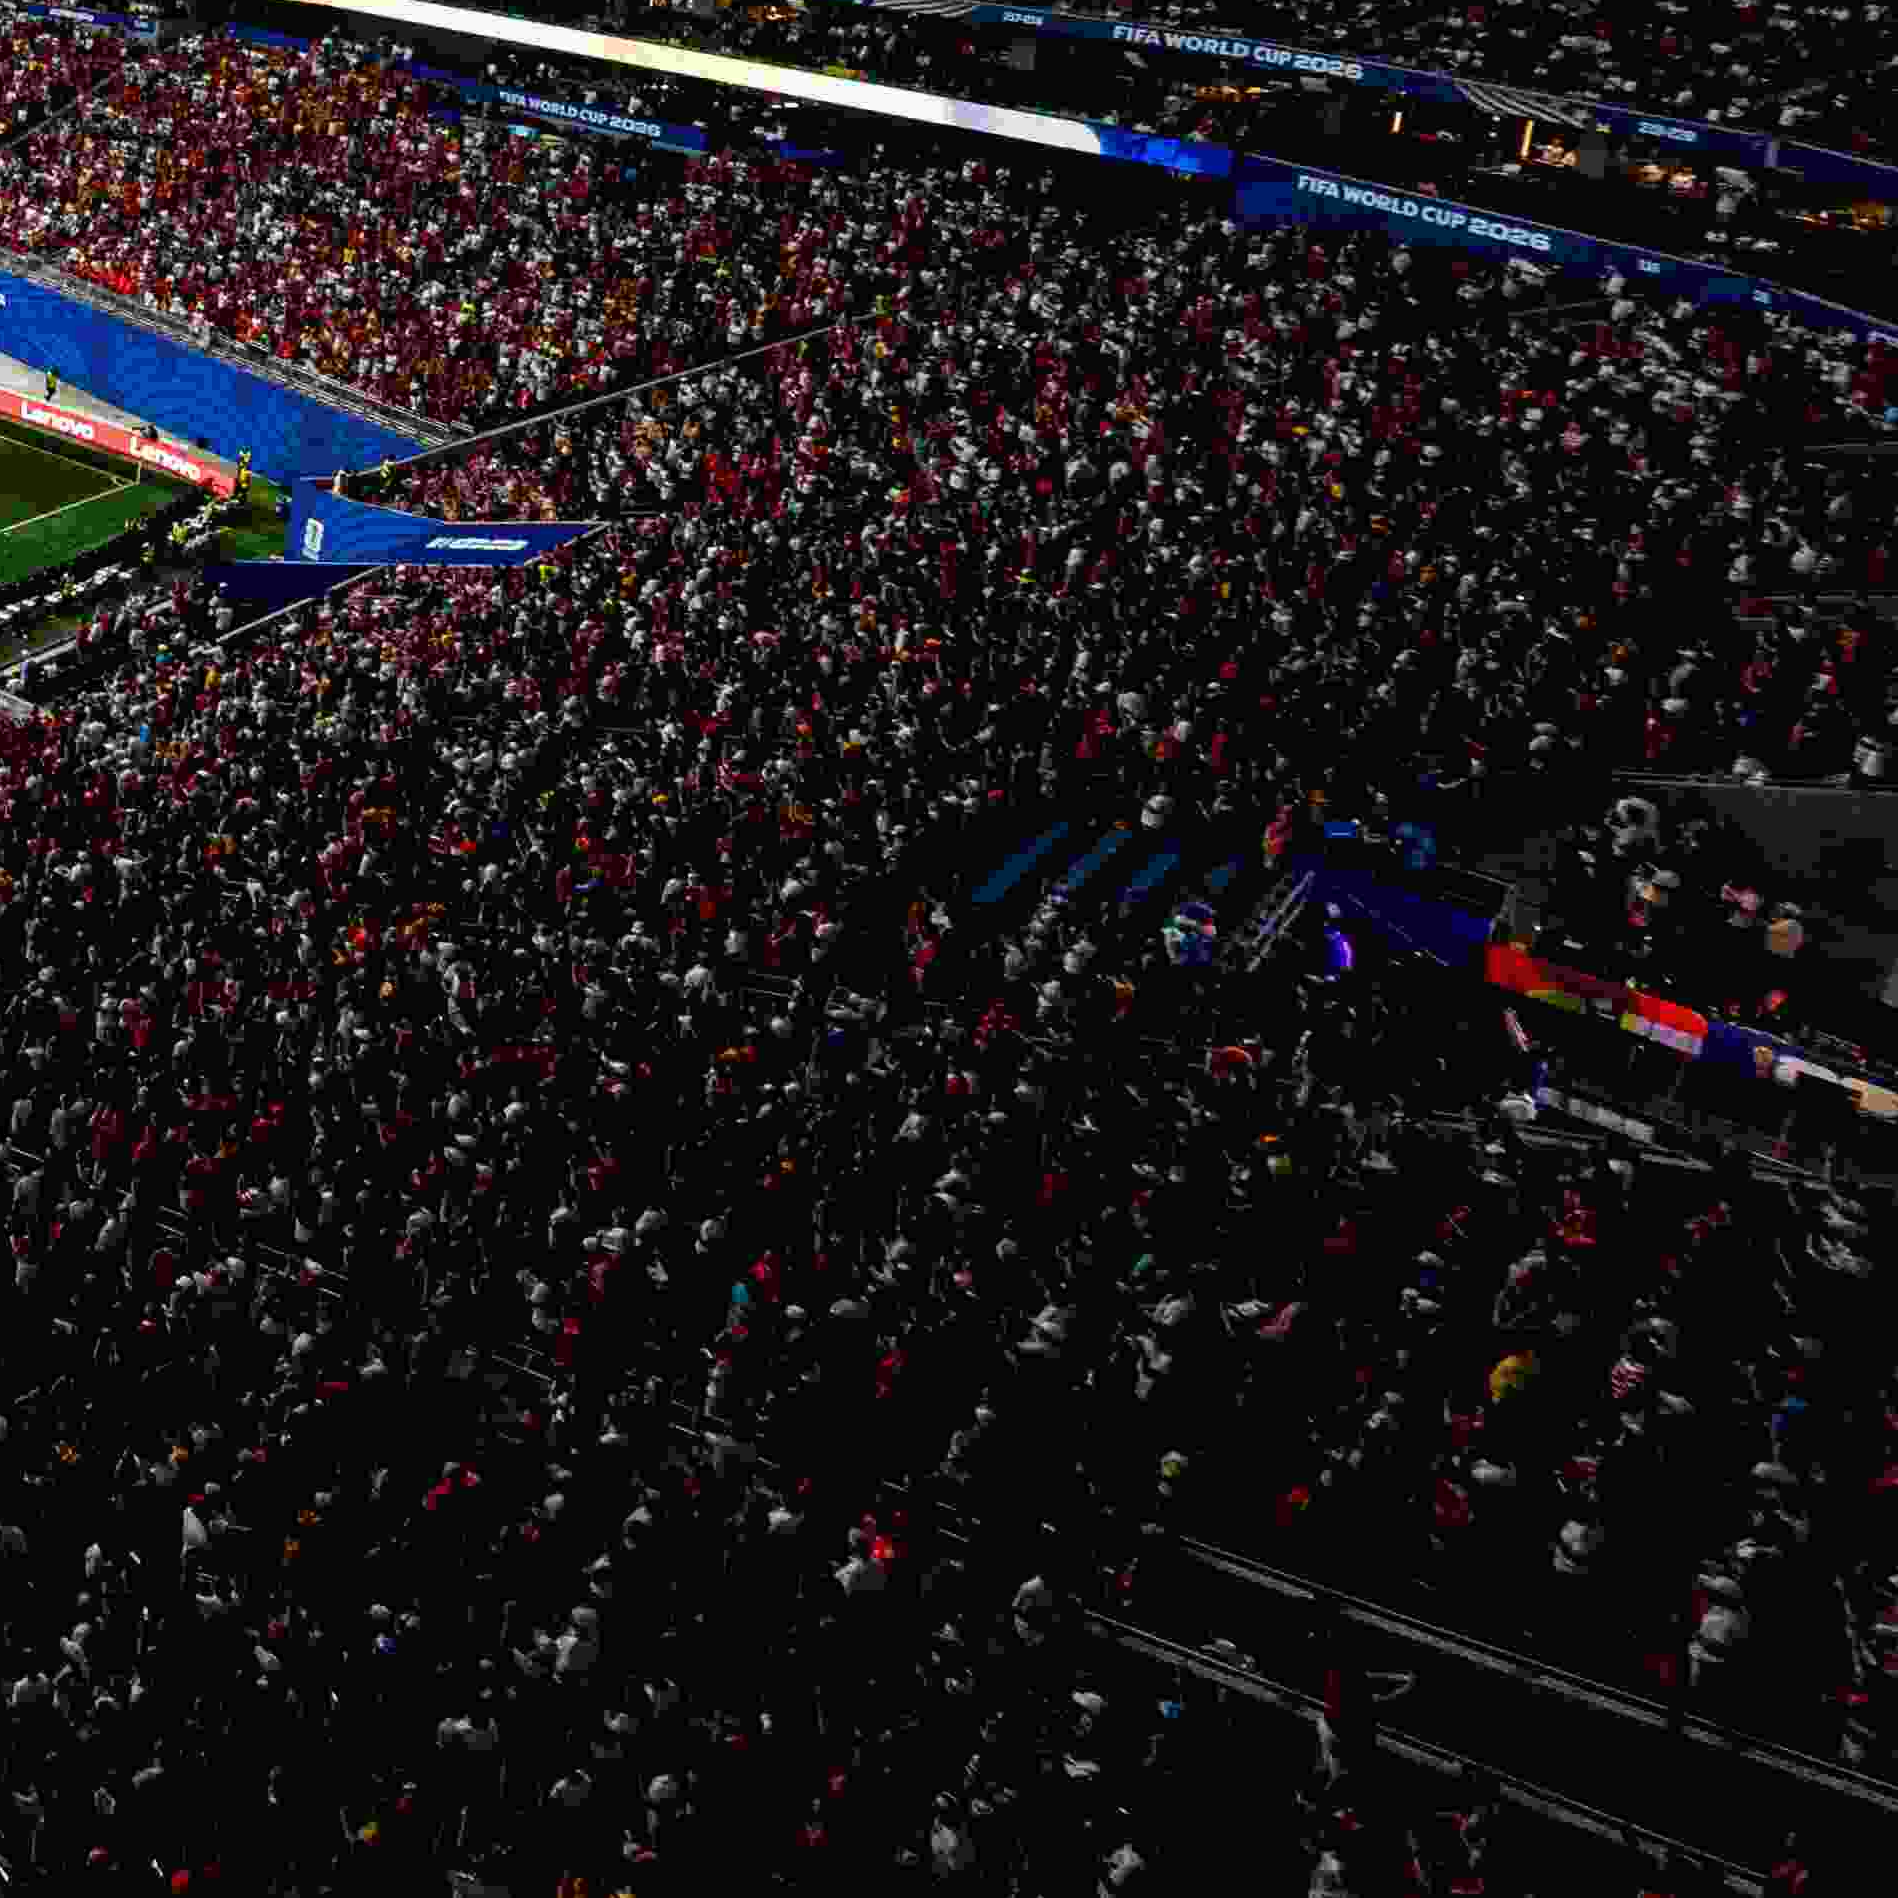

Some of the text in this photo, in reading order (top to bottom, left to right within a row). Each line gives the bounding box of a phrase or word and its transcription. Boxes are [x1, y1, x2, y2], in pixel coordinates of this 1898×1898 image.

[1112, 25, 1365, 80] FIFA WORLD CUP 2026
[525, 96, 578, 118] WORLD
[579, 108, 607, 124] CUP
[608, 116, 661, 137] 2026
[1297, 173, 1552, 251] FIFA WORLD CUP 2026
[21, 401, 95, 440] Lenovo
[129, 437, 201, 480] Lenovo
